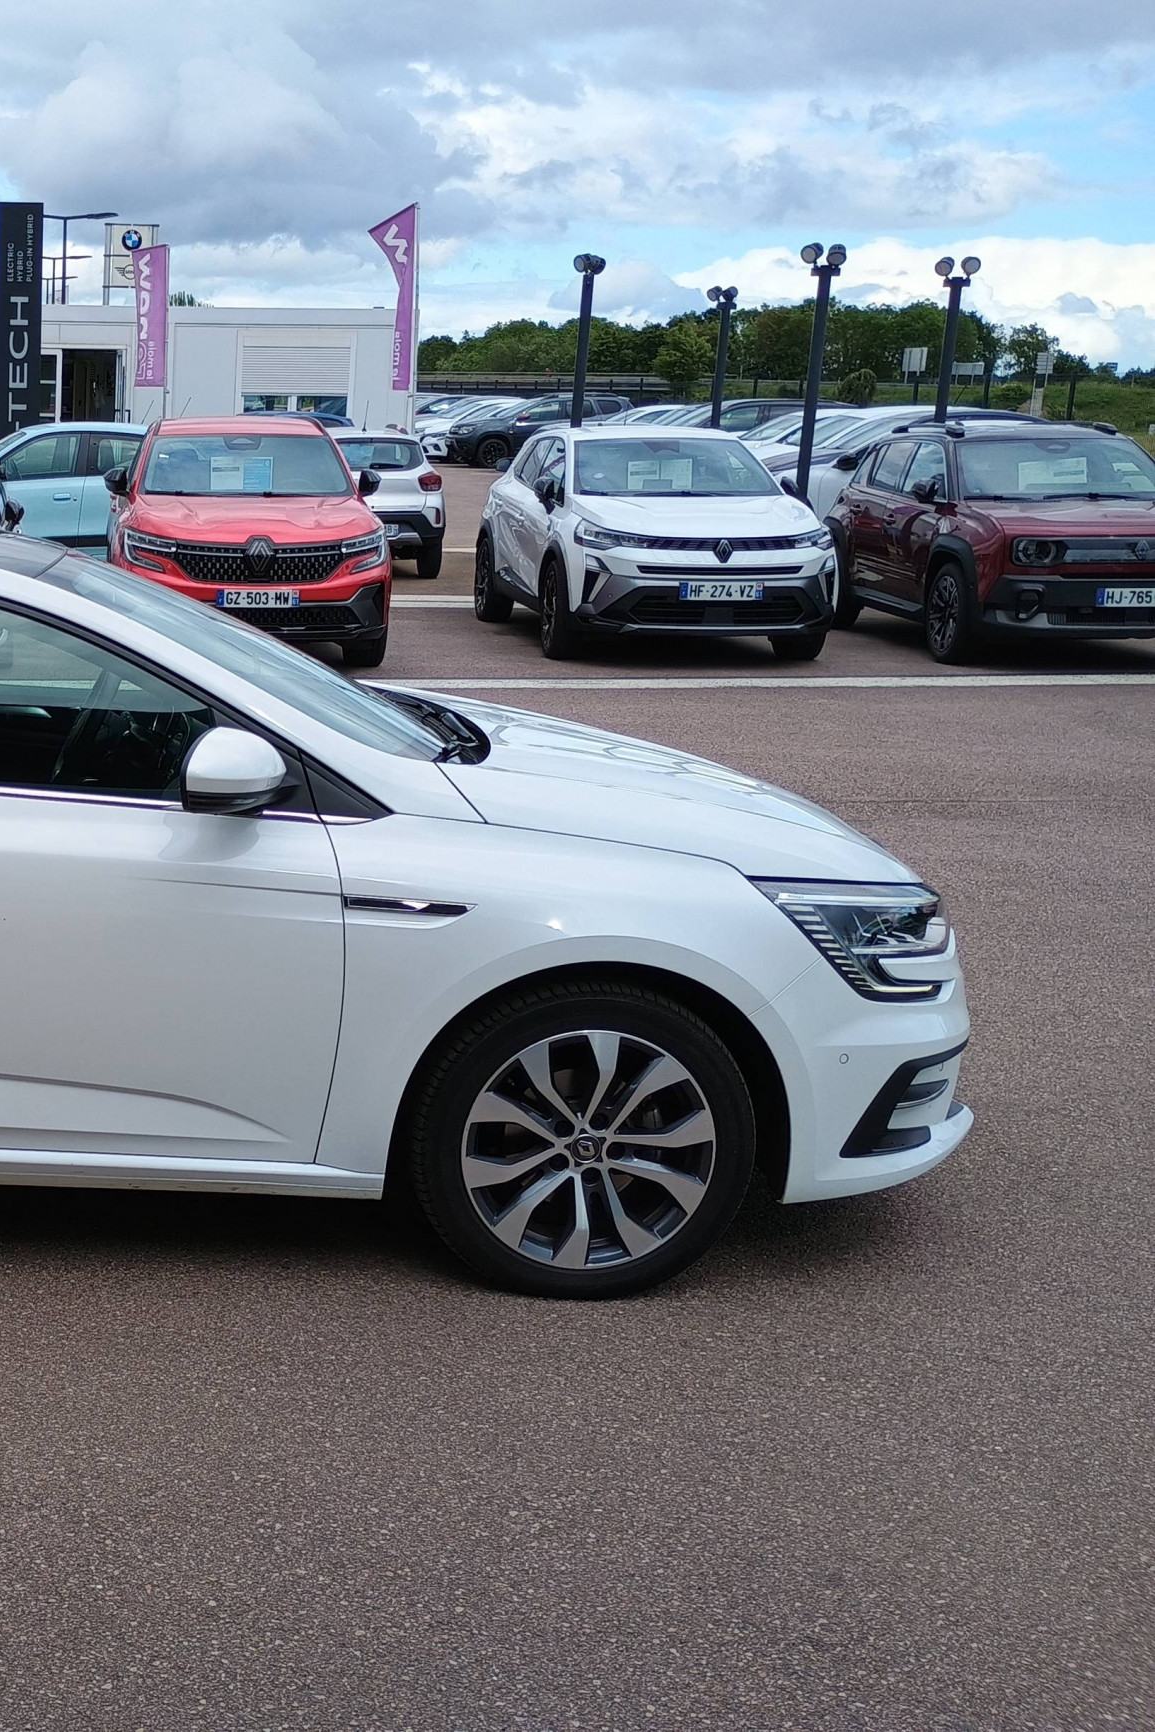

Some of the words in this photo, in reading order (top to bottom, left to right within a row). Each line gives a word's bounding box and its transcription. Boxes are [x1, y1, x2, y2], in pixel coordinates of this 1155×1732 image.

[7, 242, 15, 282] ELECTRIC
[16, 250, 24, 282] HYBRID
[26, 247, 34, 283] PLUG-IN
[8, 296, 29, 432] -TECH
[226, 591, 290, 606] GZ-503-MW
[689, 584, 755, 598] HF-274-VZ
[1106, 590, 1154, 605] HJ-765
